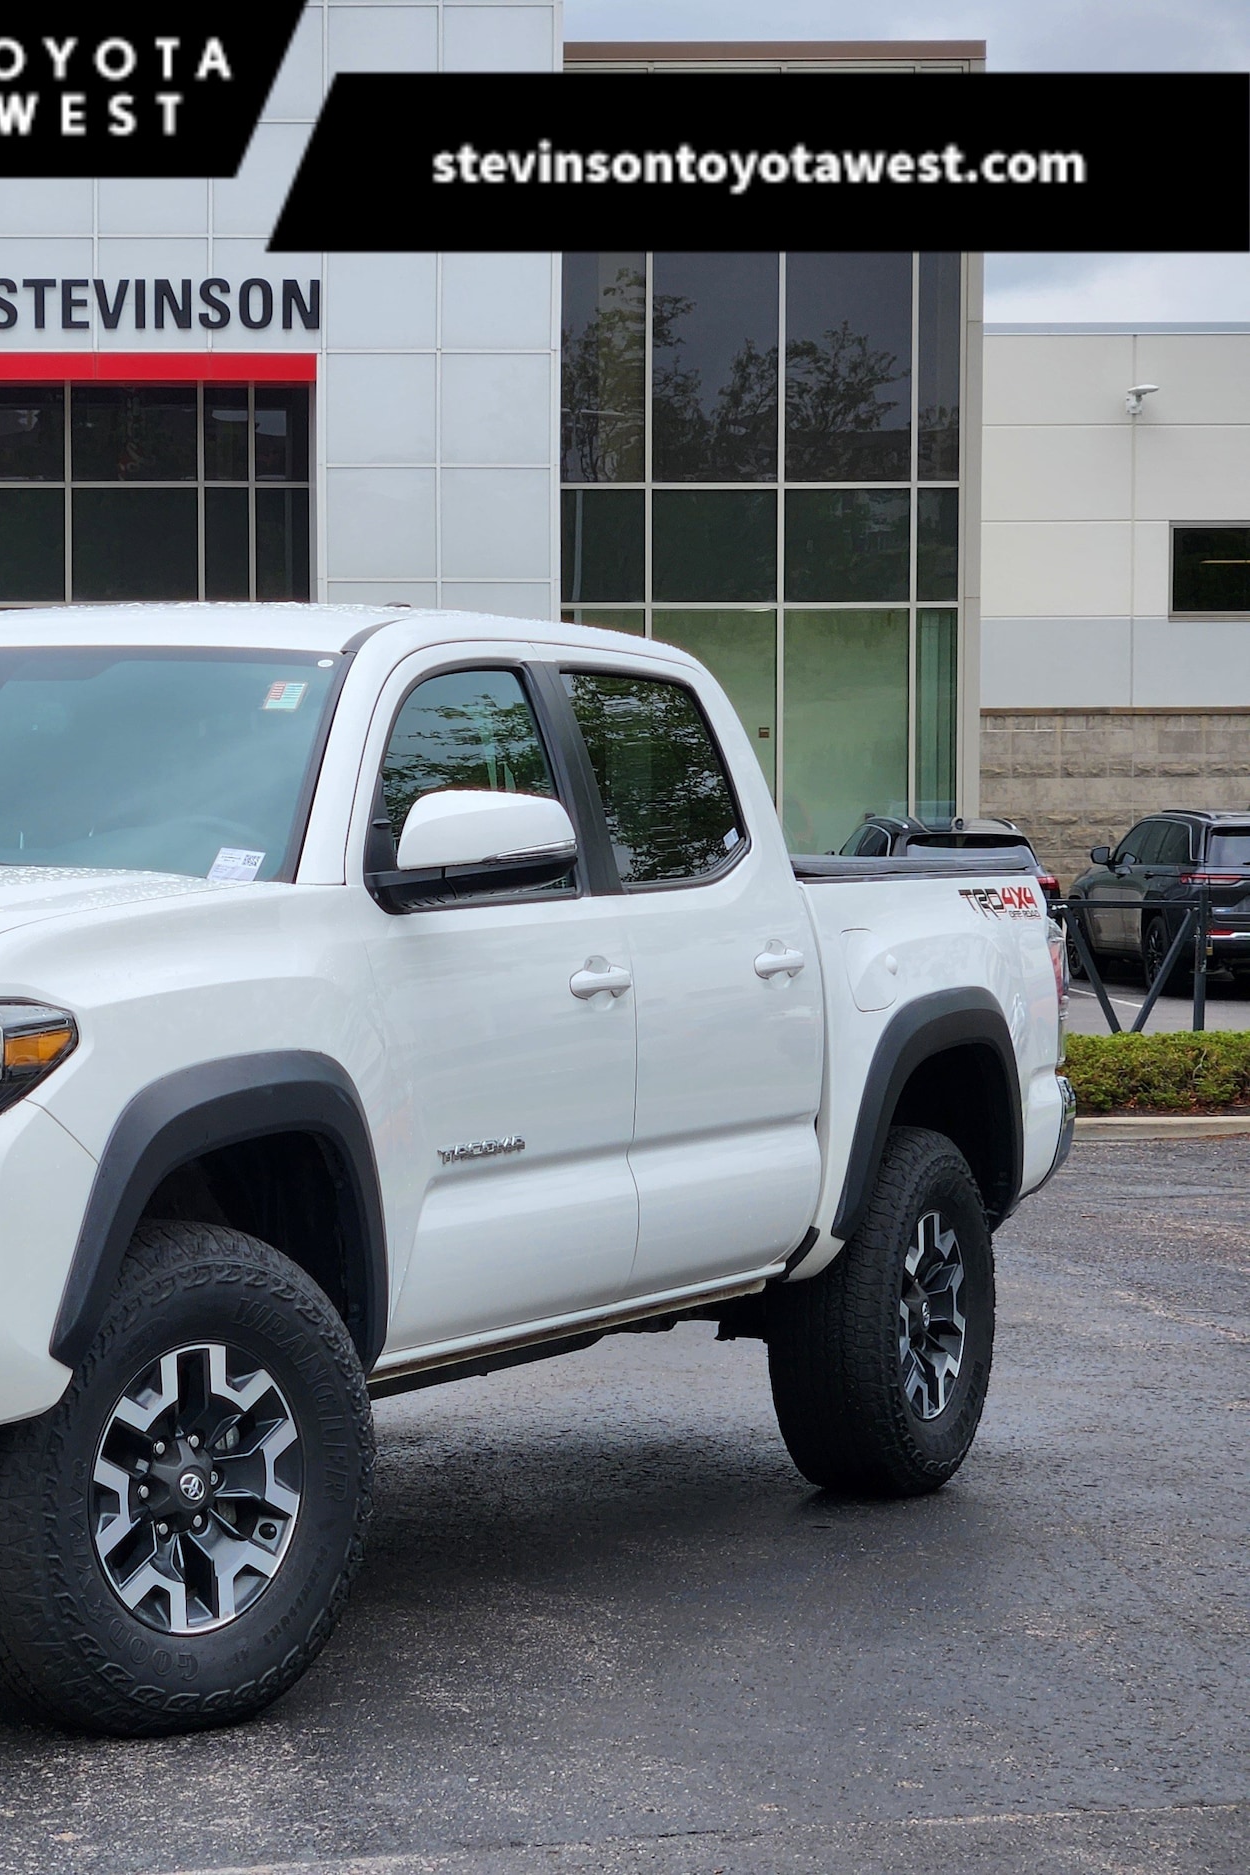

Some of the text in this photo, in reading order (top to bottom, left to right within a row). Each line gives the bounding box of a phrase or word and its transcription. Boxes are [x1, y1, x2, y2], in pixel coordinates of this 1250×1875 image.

[958, 886, 1039, 920] TRD 4X4
[1008, 910, 1042, 920] OFF ROAD
[437, 1135, 525, 1165] TACOMA
